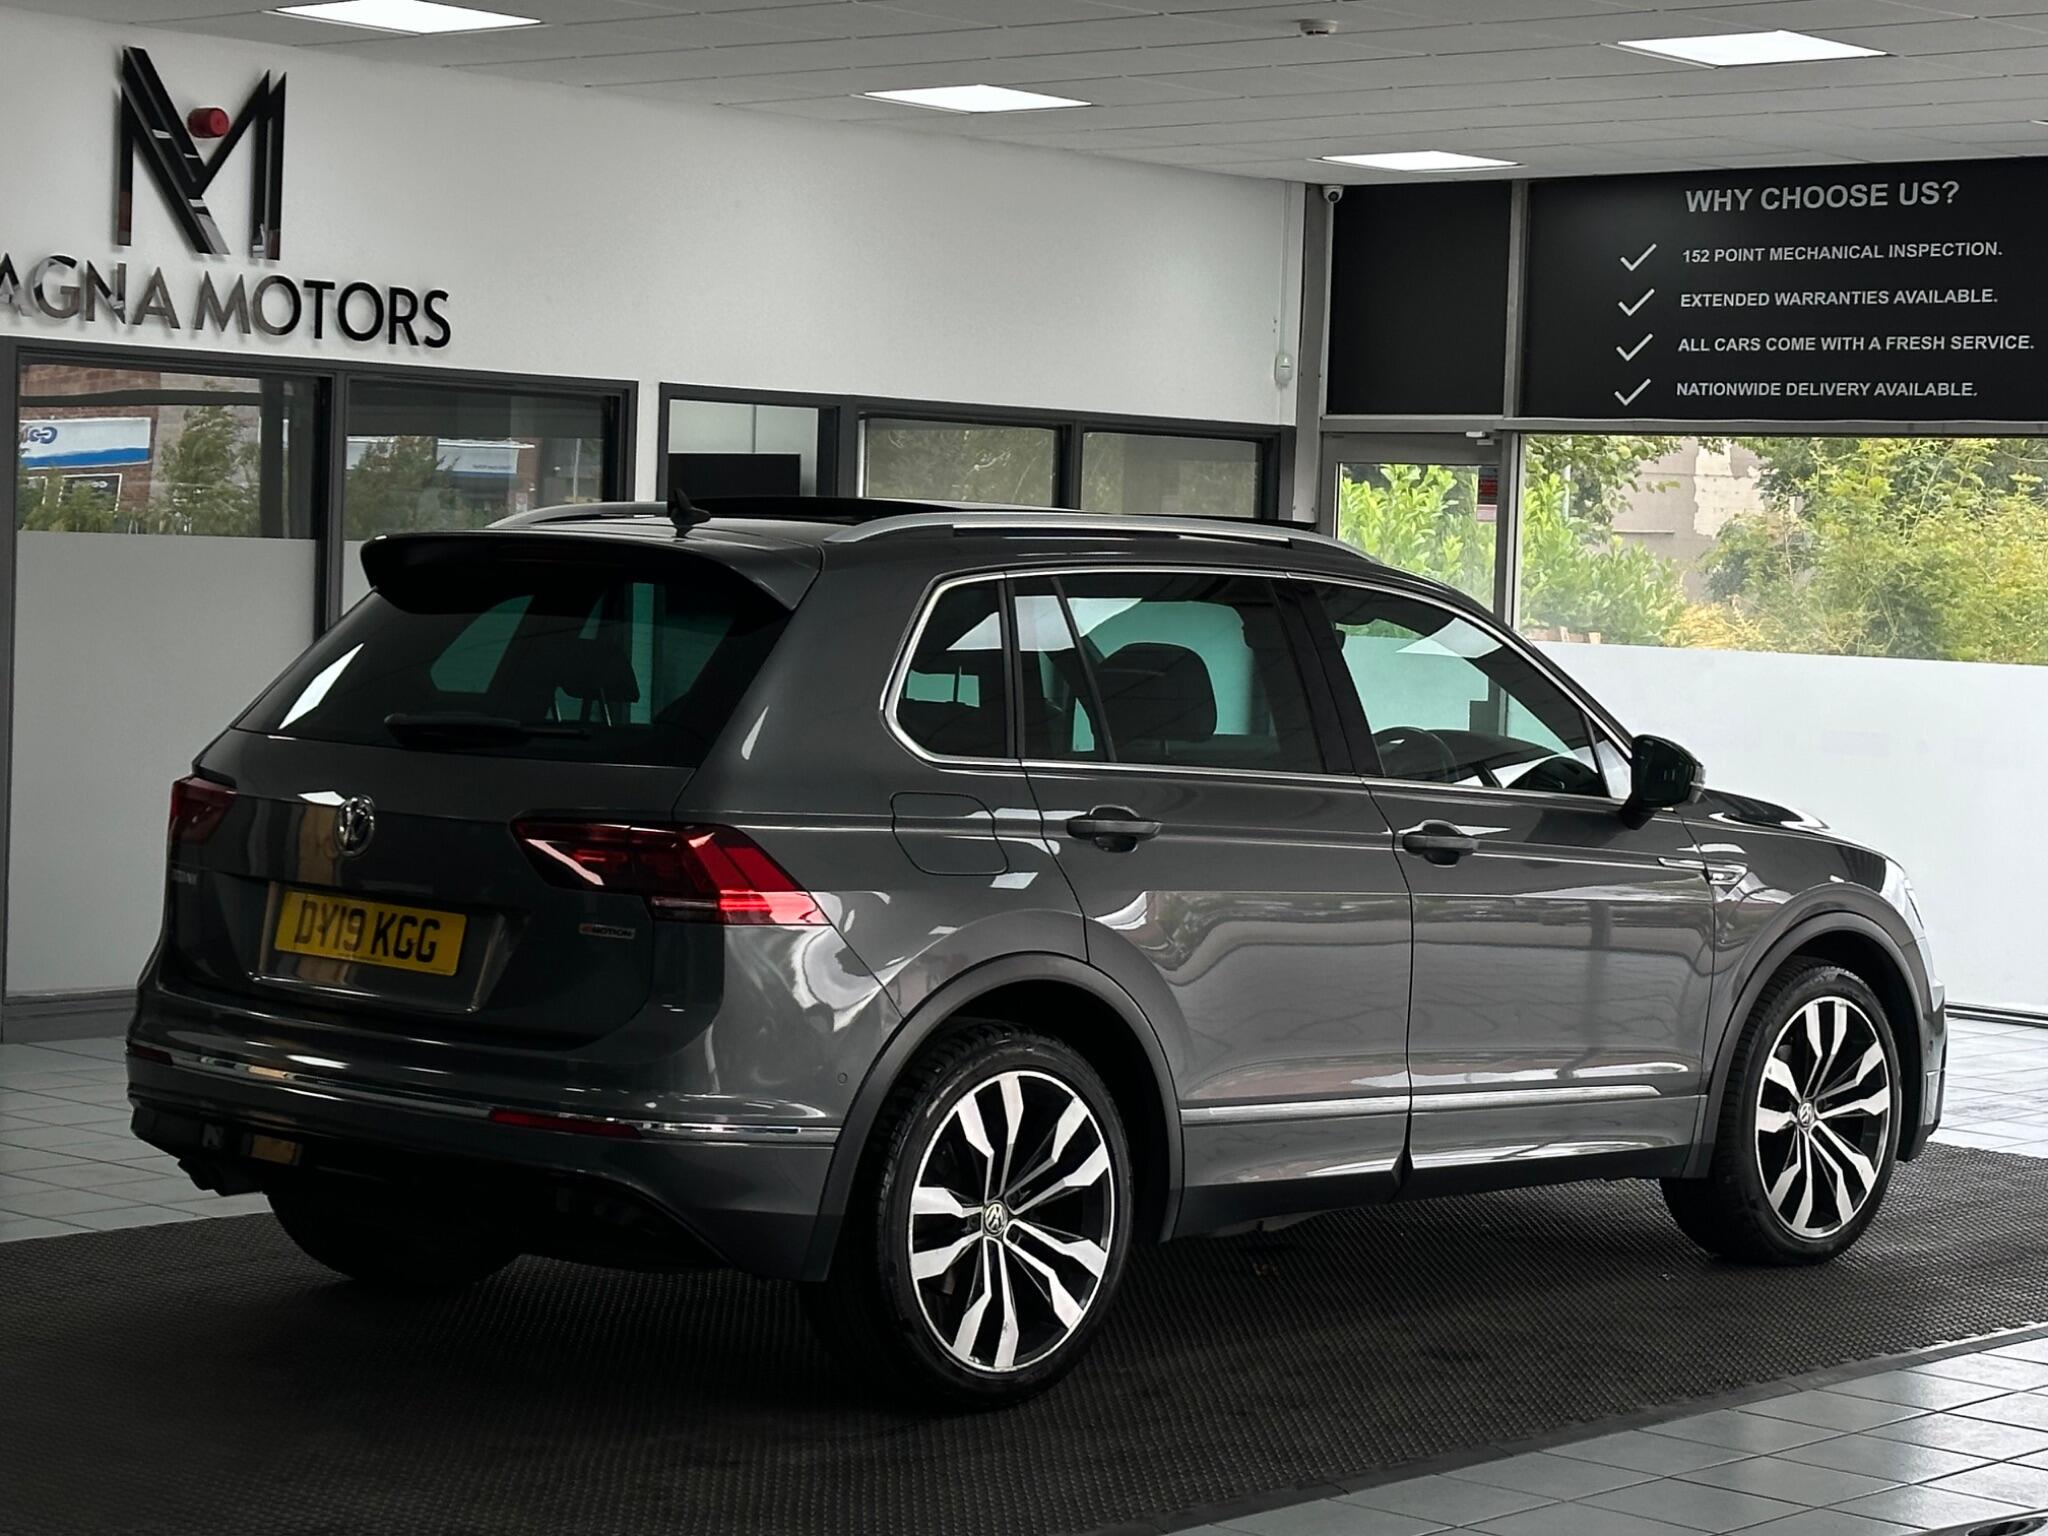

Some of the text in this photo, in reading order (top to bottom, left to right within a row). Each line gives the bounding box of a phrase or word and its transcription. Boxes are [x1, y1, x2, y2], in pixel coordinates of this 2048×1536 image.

[1685, 180, 1960, 213] WHY CHOOSE US?
[1682, 241, 2004, 263] 152 POINT MECHANICAL INSPECTION.
[1680, 288, 1999, 308] EXTENDED WARRANTIES AVAILABLE.
[193, 270, 451, 349] MOTORS
[1677, 335, 2035, 352] ALL CARS COME WITH A FRESH SERVICE.
[1676, 382, 1782, 396] NATIONWIDE
[1786, 382, 1871, 396] DELIVERY
[294, 899, 441, 963] DY19 KGG
